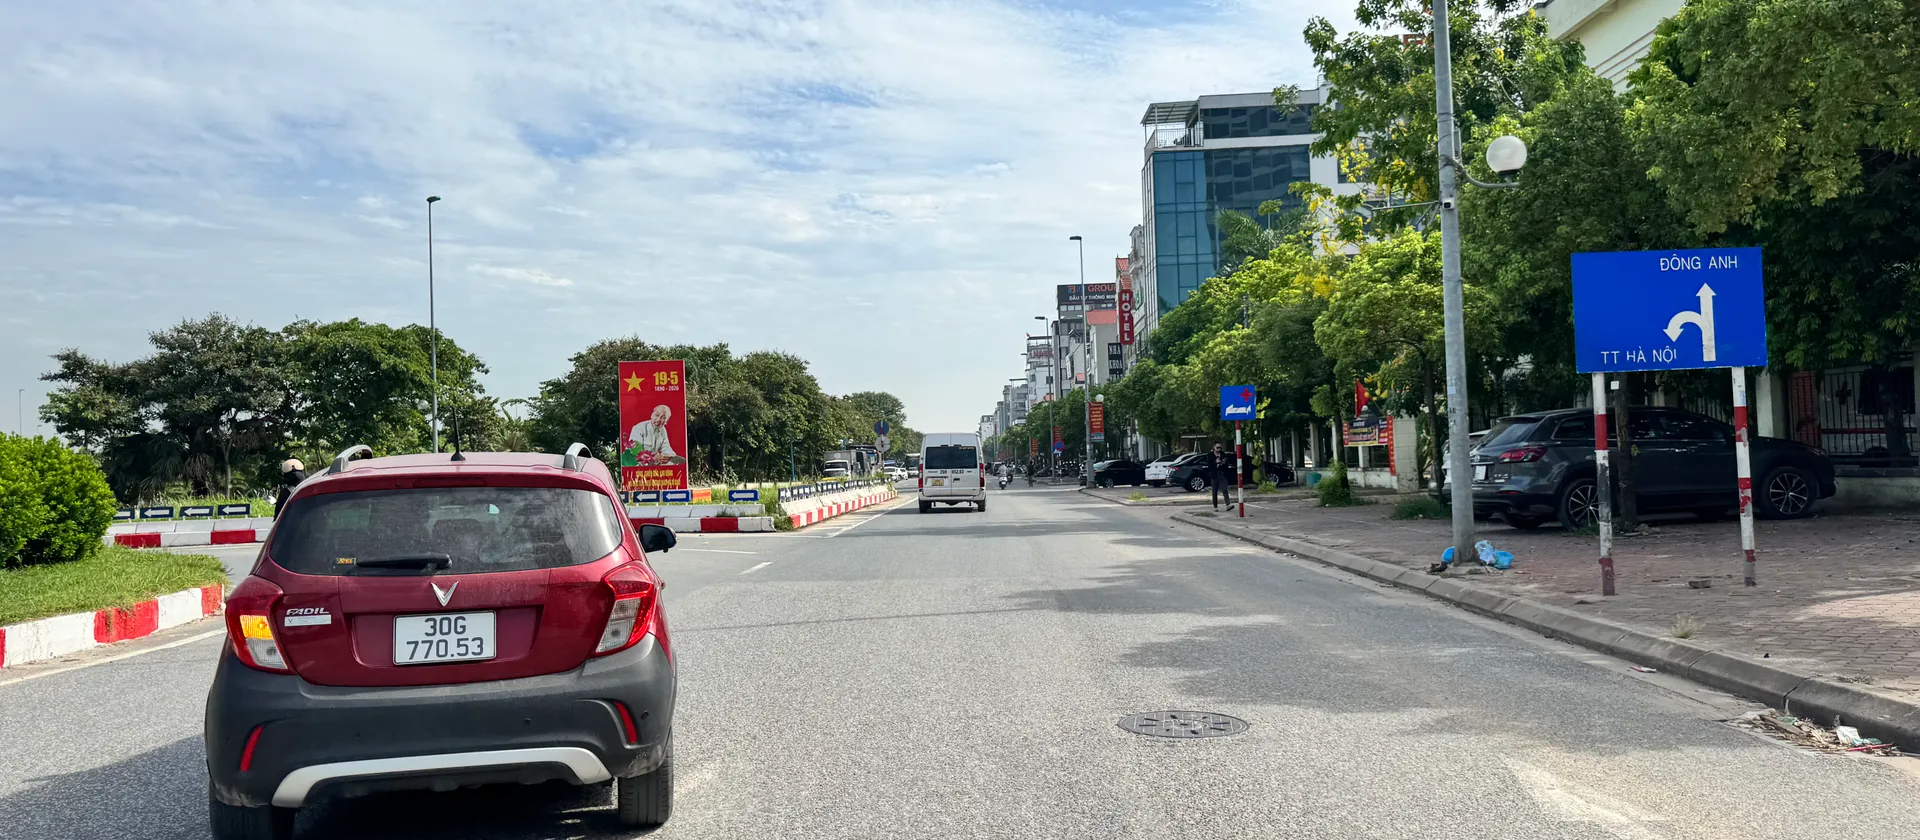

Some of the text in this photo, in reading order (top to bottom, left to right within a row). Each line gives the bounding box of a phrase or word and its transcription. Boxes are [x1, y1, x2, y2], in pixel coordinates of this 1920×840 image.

[1660, 254, 1738, 271] ĐÔNG ANH
[1122, 293, 1131, 341] HOTEL
[1601, 345, 1677, 364] TT HÀ NỘI
[286, 607, 330, 615] FADIL
[425, 616, 466, 636] 30G
[406, 637, 483, 660] 770.53
